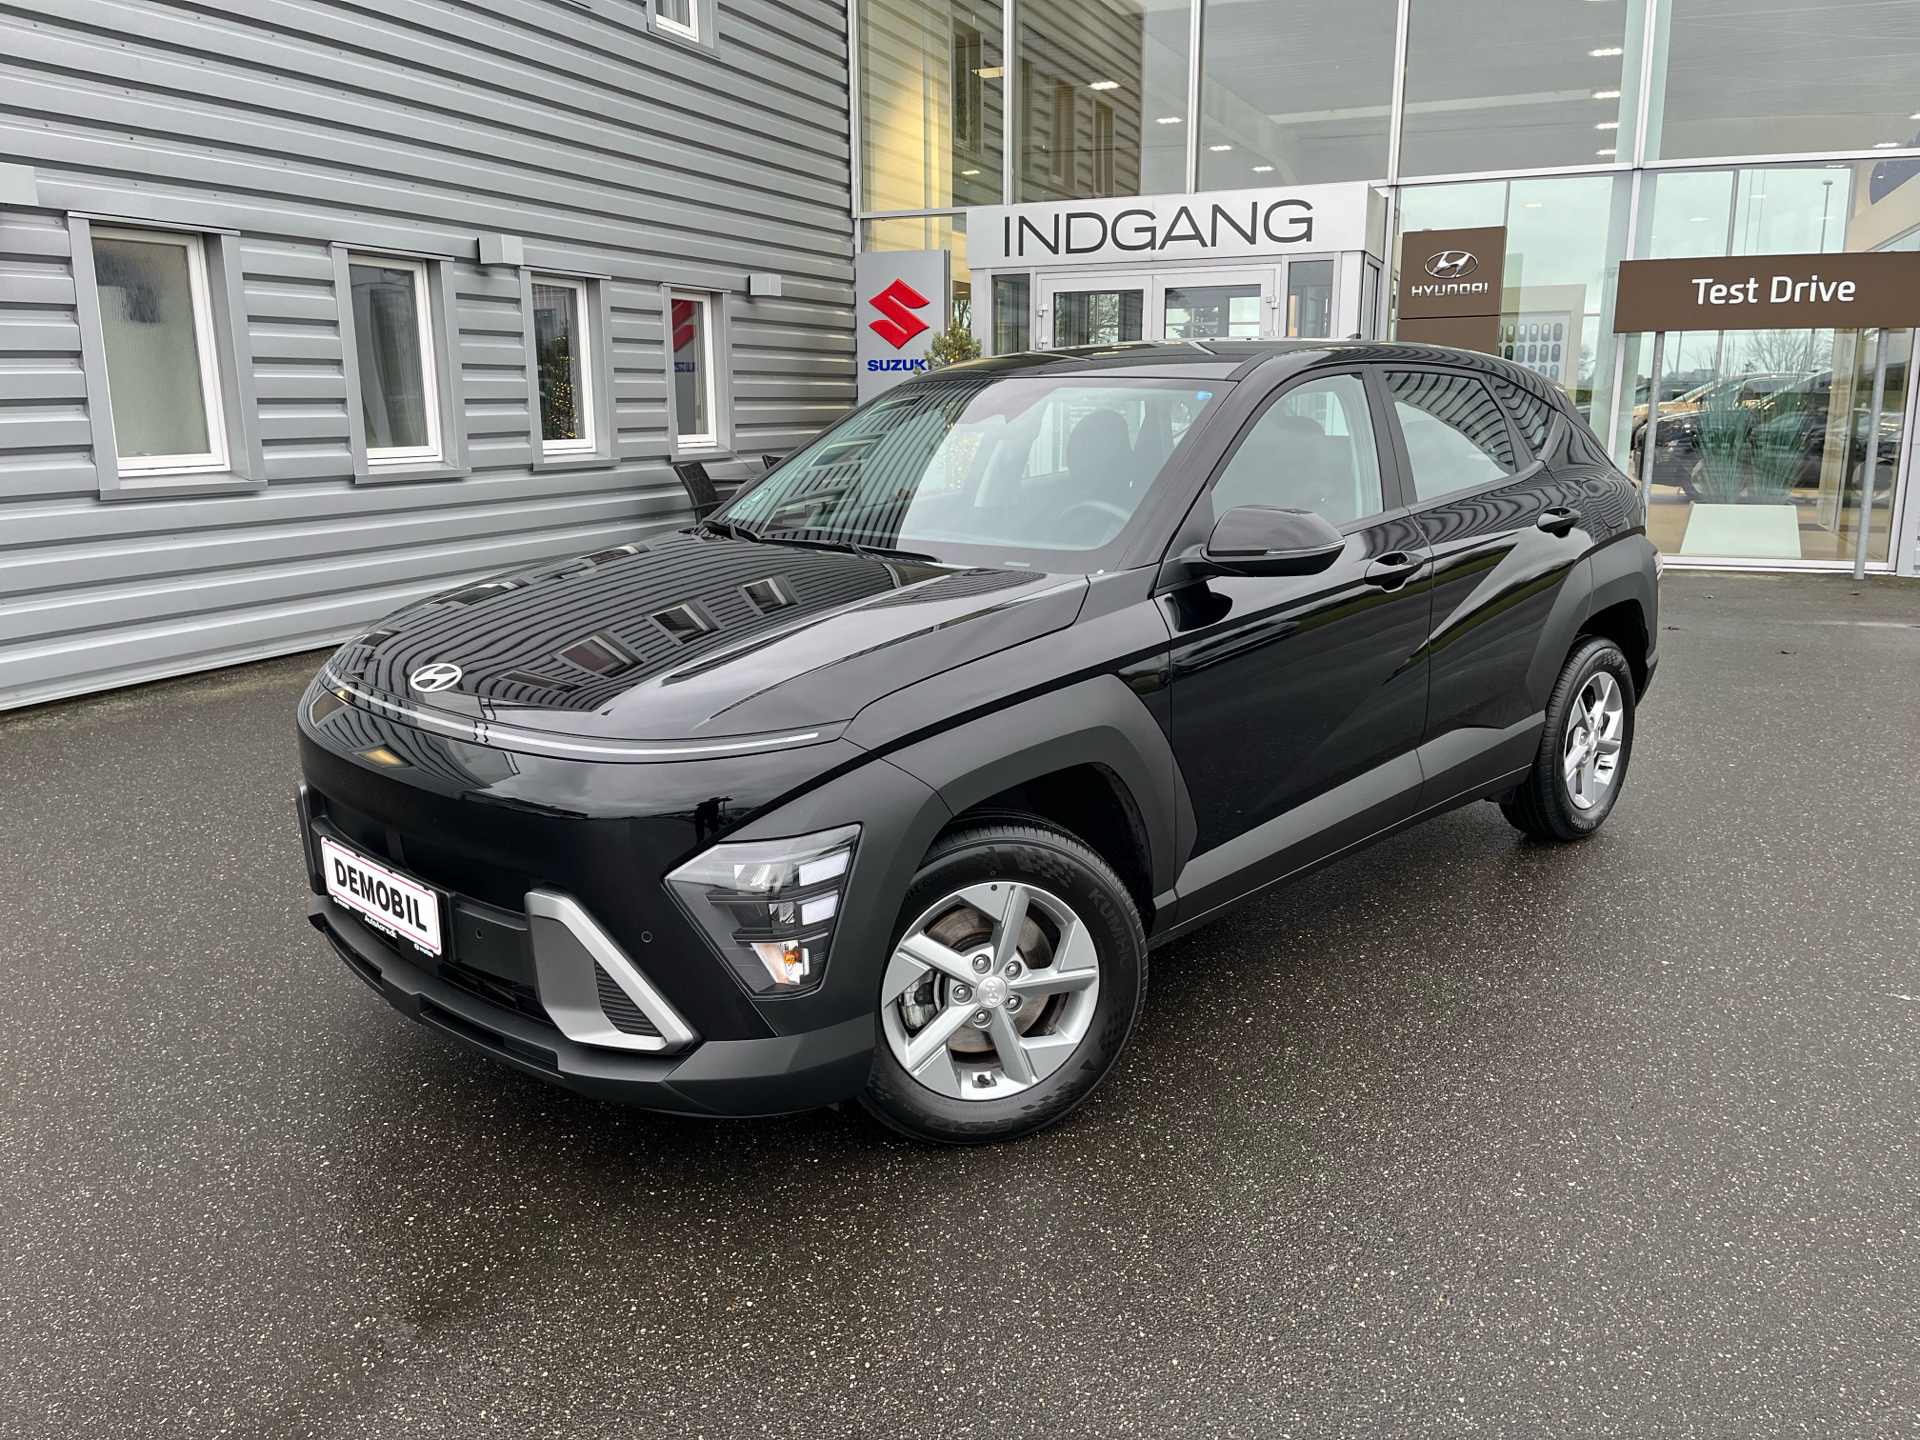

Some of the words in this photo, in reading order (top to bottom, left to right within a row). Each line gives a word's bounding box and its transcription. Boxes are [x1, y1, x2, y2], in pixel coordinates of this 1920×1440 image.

[1004, 199, 1313, 257] INDGANG
[1411, 282, 1489, 297] HYUNDAI
[1691, 277, 1759, 305] Test
[1769, 274, 1856, 303] Drive
[333, 856, 428, 933] DEMOBIL
[1087, 887, 1133, 973] KUMHO
